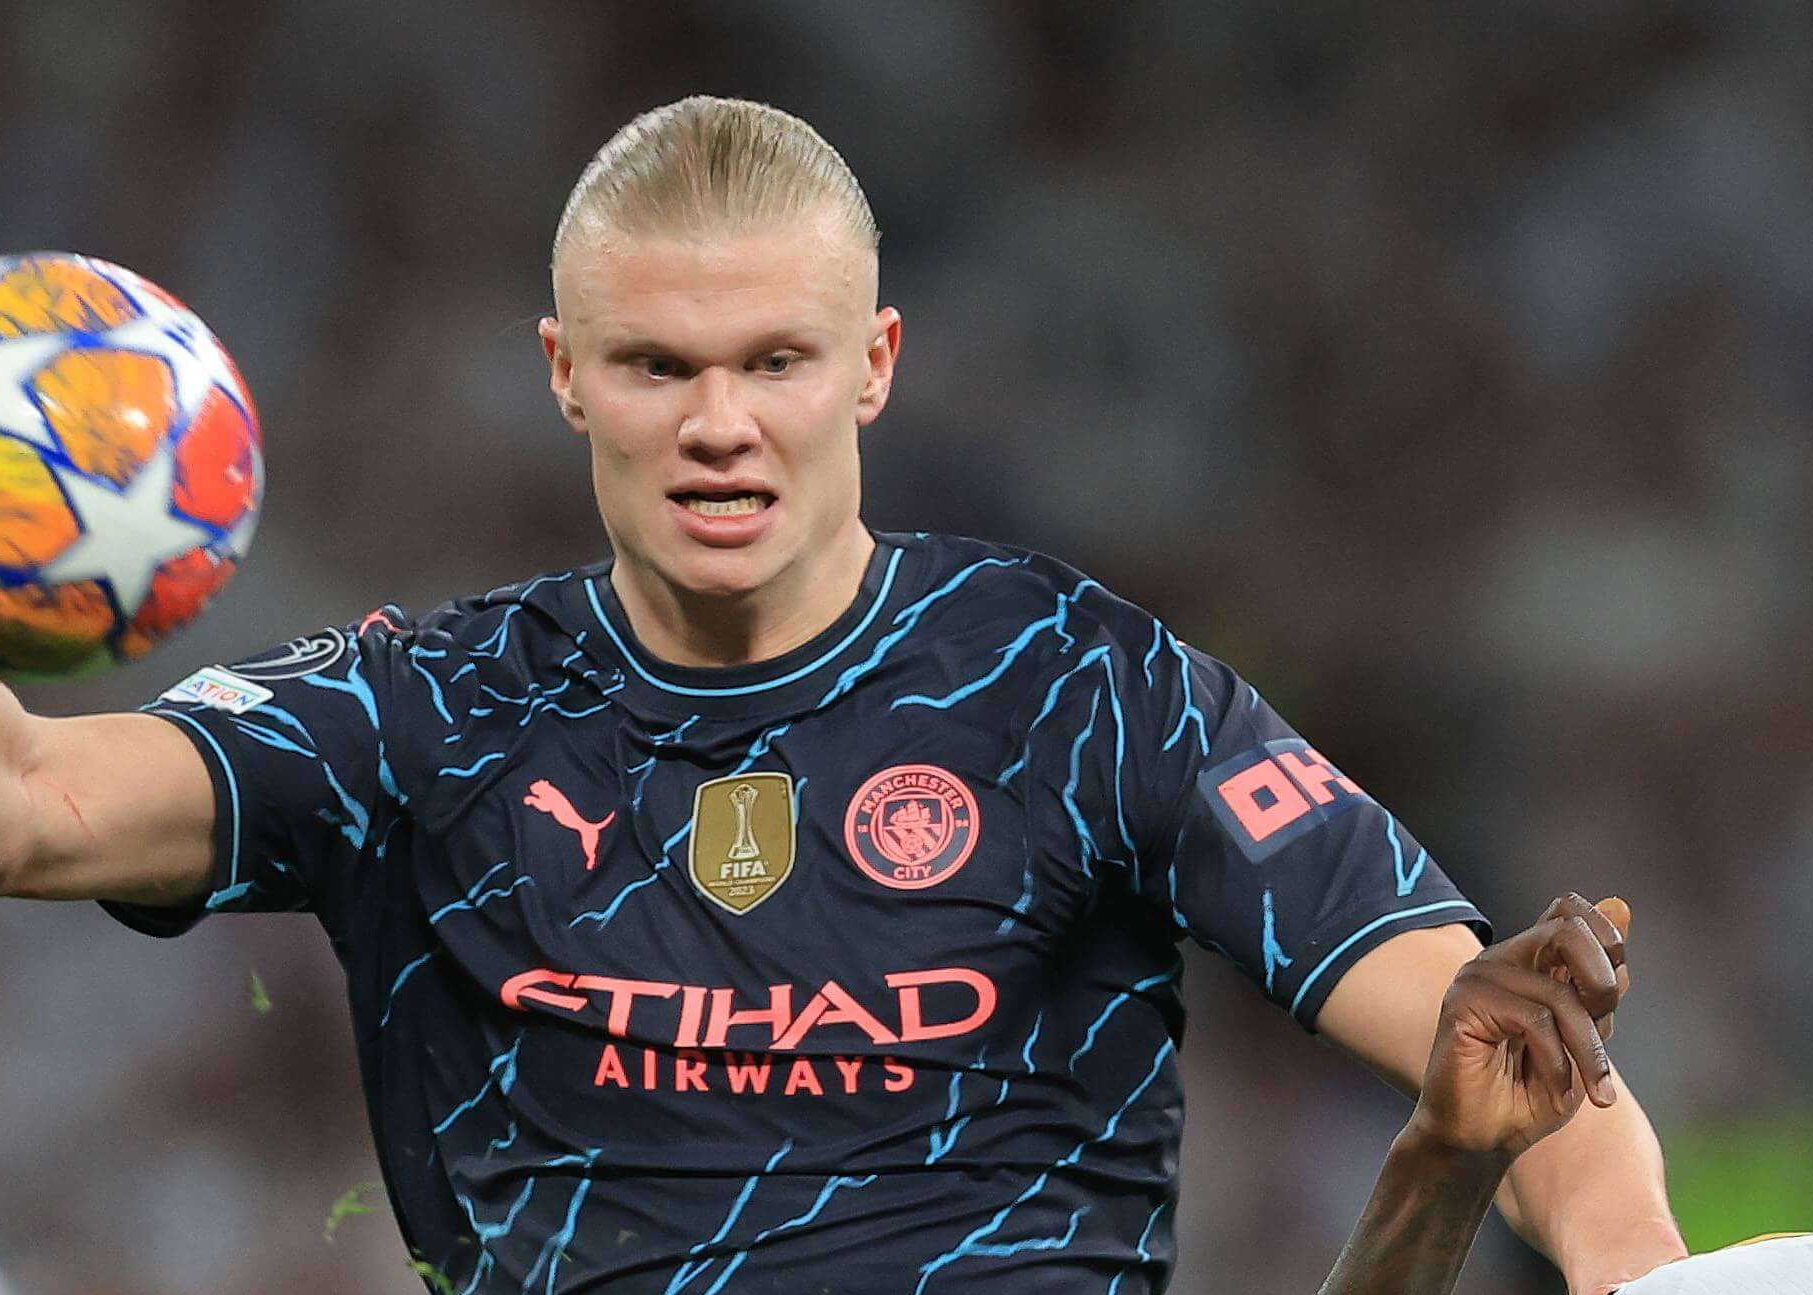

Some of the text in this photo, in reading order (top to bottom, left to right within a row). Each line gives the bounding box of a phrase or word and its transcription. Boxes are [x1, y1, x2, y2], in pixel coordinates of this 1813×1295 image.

[861, 774, 964, 814] MANCHESTER
[720, 860, 766, 879] FIFA
[893, 866, 932, 880] CITY
[501, 968, 998, 1049] ETIHAD
[594, 1044, 916, 1096] AIRWAYS
